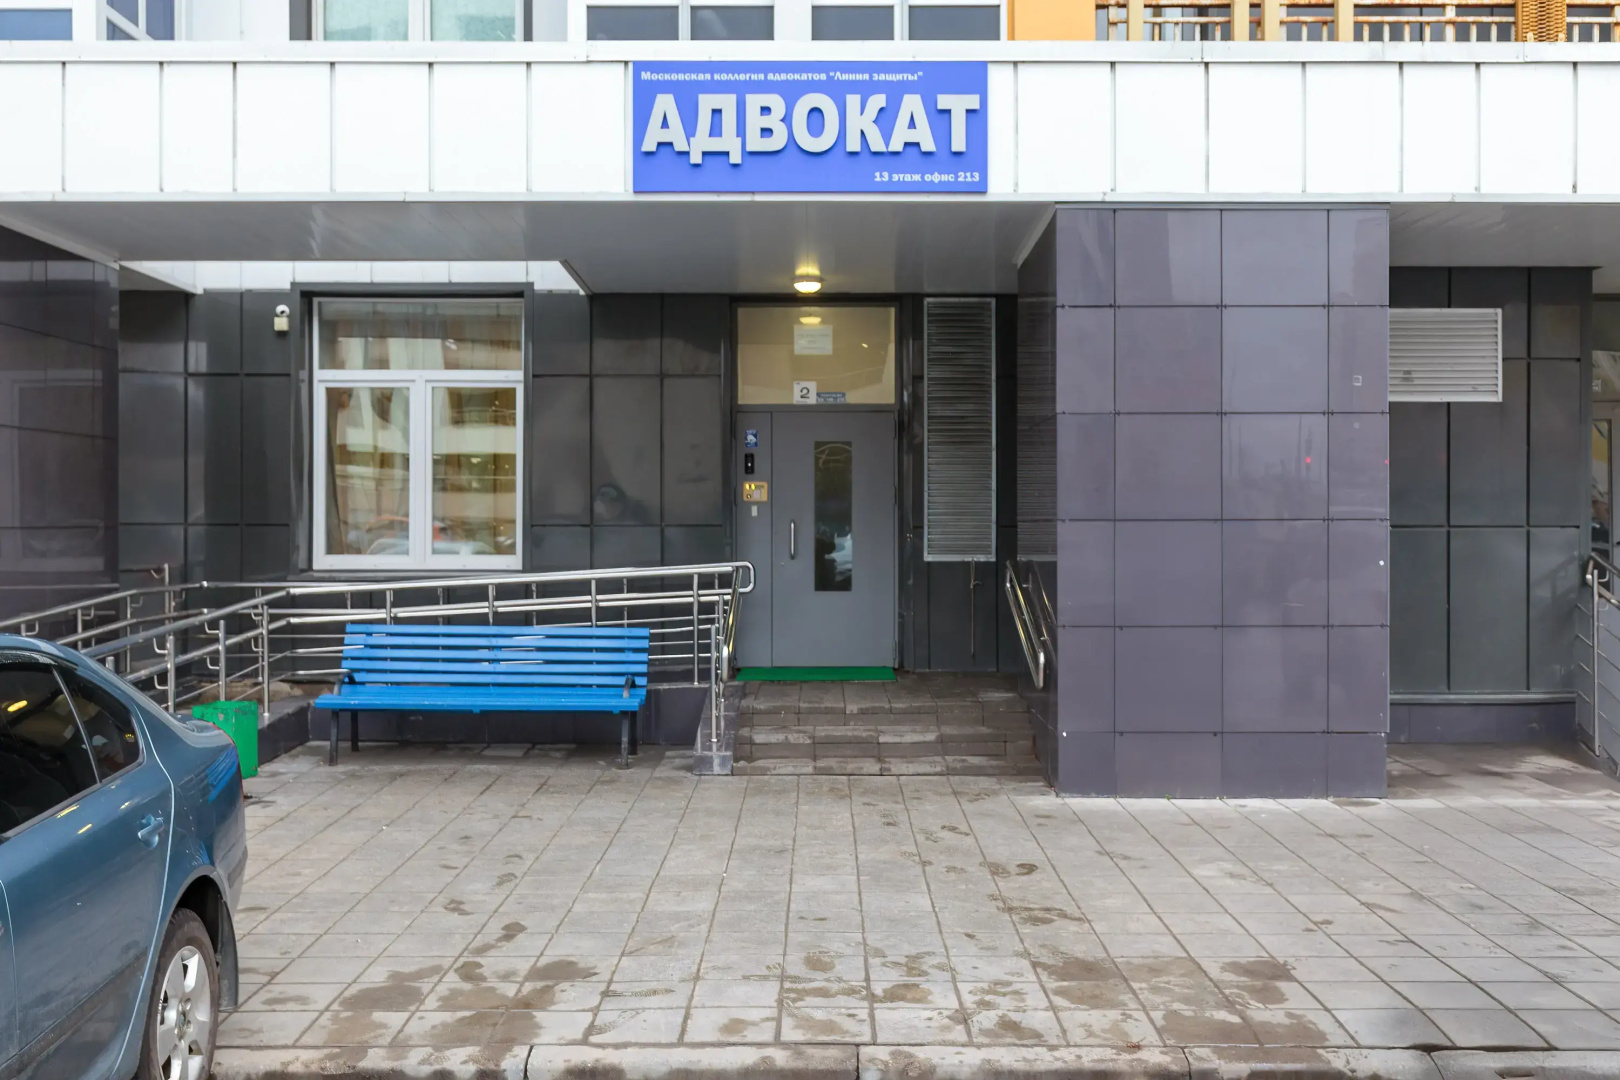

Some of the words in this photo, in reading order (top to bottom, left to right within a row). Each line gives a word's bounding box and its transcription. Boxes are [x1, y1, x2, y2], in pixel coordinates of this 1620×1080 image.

[640, 71, 711, 81] Московская
[767, 72, 827, 82] адвокатов
[641, 93, 981, 165] АДВОКАТ
[874, 171, 889, 182] 13
[891, 173, 922, 182] этаж
[924, 171, 955, 184] офис
[957, 171, 980, 182] 213
[799, 386, 811, 400] 2
